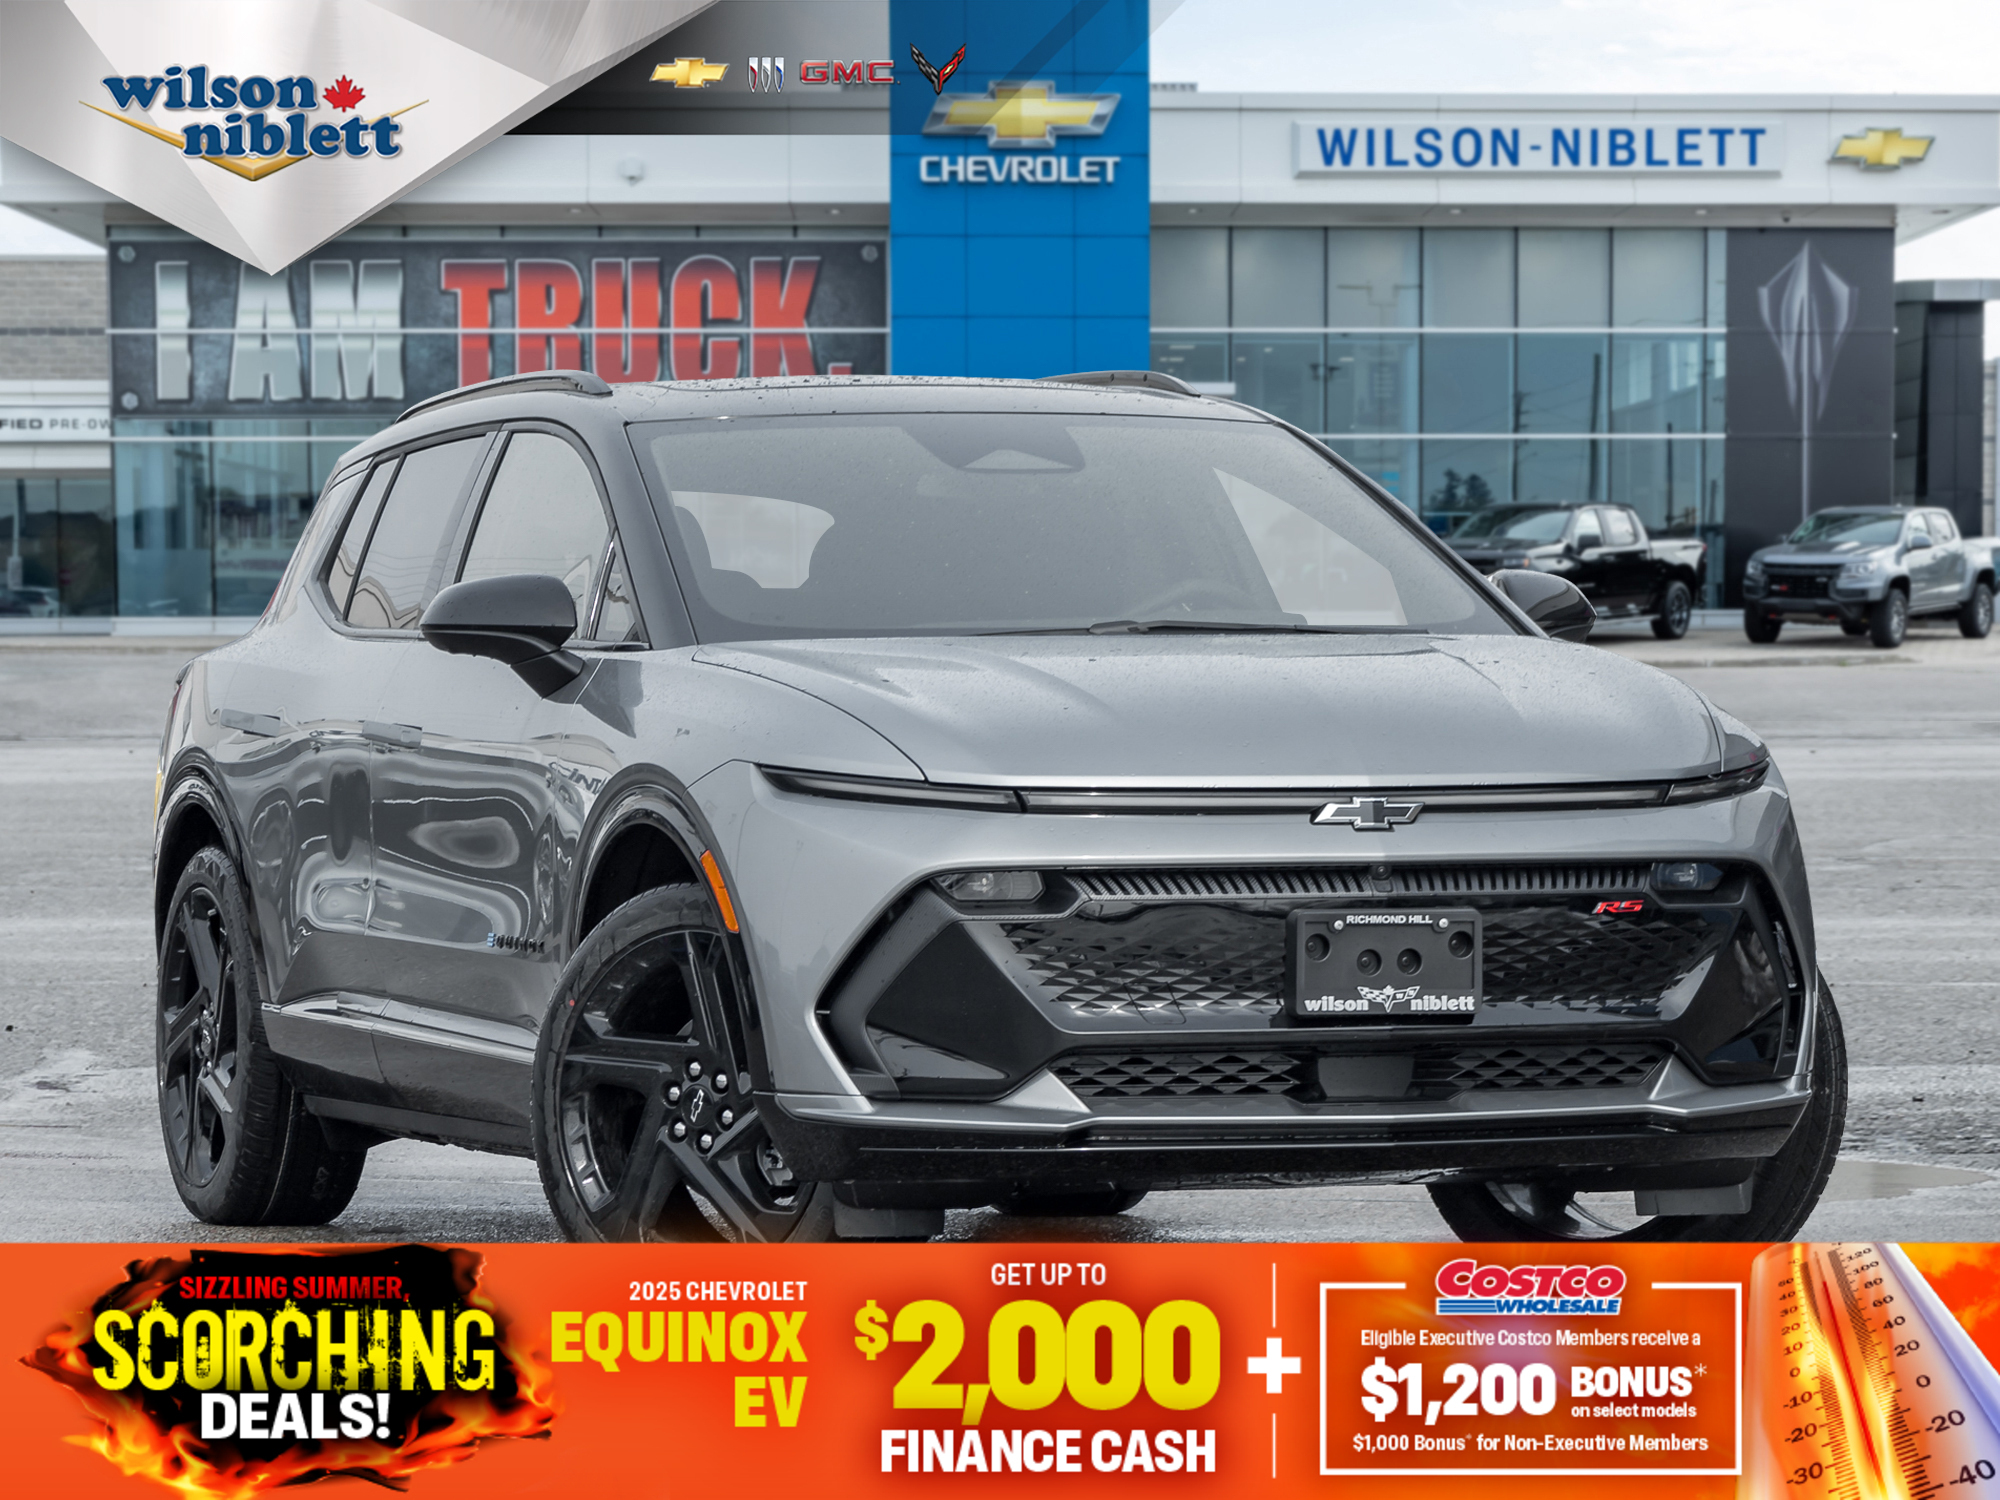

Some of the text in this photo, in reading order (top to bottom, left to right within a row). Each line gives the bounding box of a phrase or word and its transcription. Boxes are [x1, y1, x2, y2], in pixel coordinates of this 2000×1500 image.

[1316, 127, 1767, 167] WILSON-NIBLETT
[919, 154, 1122, 183] CHEVROLET
[156, 260, 190, 400] I
[229, 259, 404, 401] AM
[1591, 899, 1644, 914] RS
[1346, 914, 1434, 925] RICHMOND HILL
[1304, 994, 1476, 1012] wilson niblett
